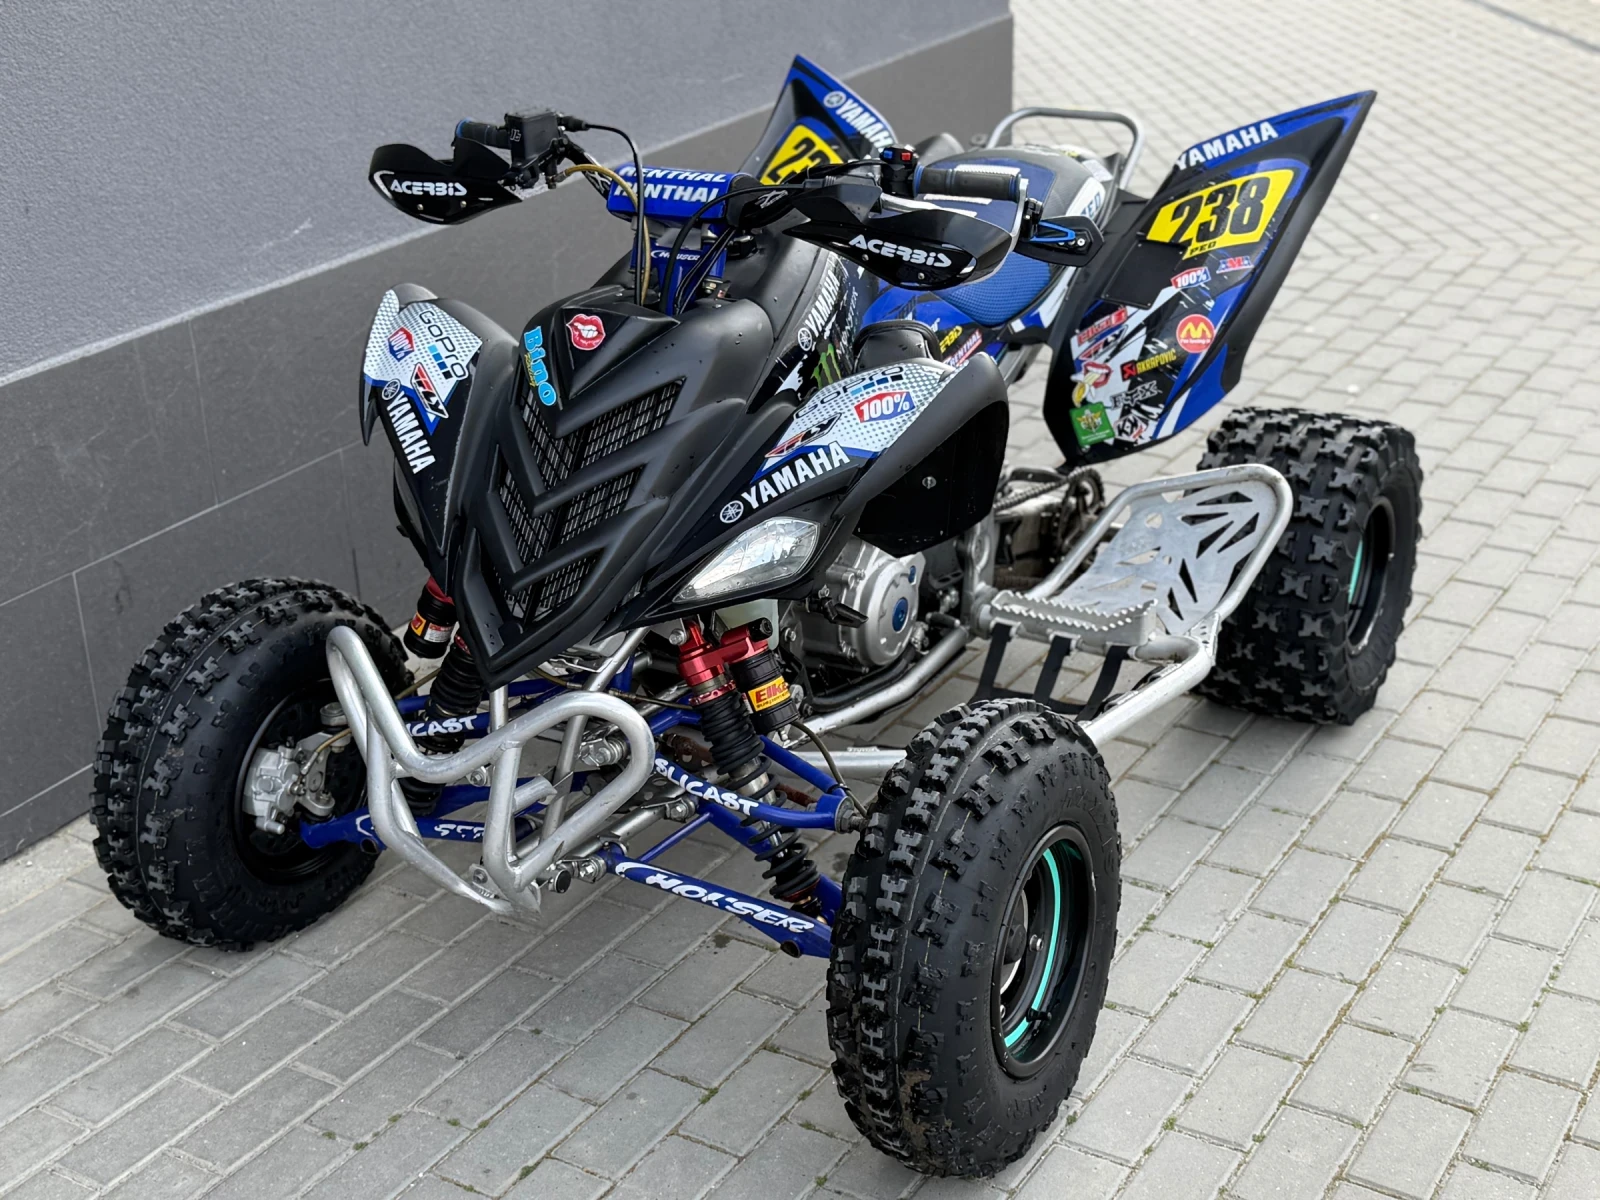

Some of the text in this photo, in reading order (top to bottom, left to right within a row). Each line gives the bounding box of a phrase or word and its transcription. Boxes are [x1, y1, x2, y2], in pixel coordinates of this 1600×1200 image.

[836, 98, 894, 152] YAMAH
[1176, 121, 1278, 171] YAMAHA
[1168, 177, 1272, 244] 238
[804, 270, 840, 338] YAMAHA
[1176, 269, 1207, 287] 100%
[389, 329, 413, 360] 100%
[939, 325, 964, 354] ERBIS
[387, 390, 437, 474] YAMAHA
[859, 392, 911, 421] 100%
[741, 441, 851, 510] YAMAHA
